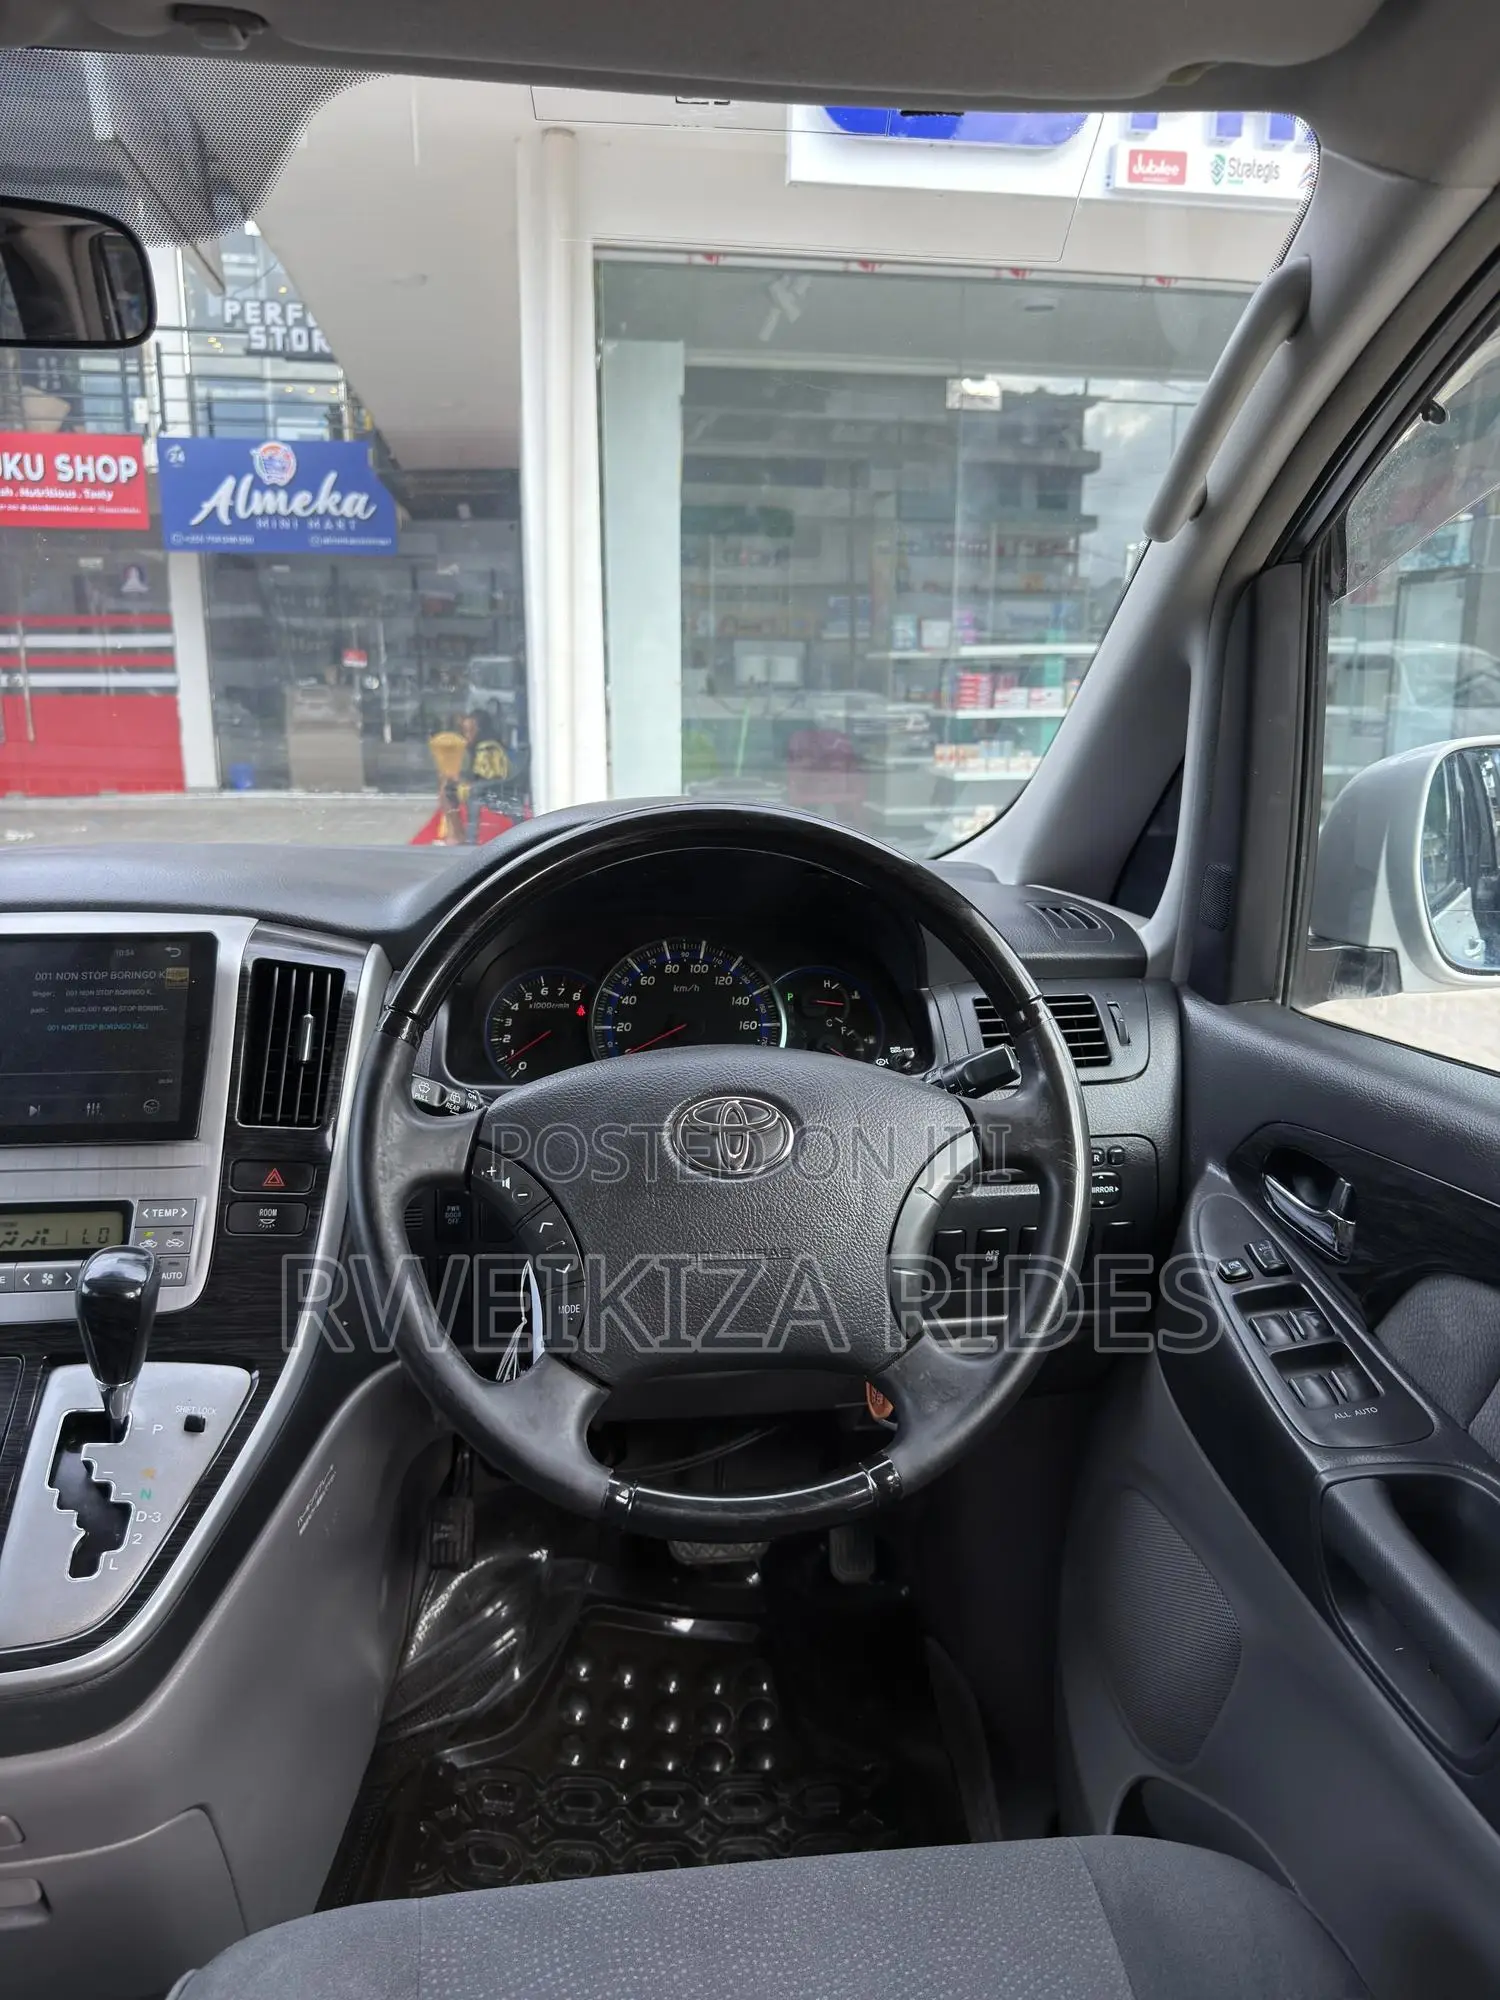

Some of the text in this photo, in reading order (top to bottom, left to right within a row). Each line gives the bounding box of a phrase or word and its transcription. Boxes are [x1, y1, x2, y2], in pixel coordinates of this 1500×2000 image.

[1132, 153, 1180, 177] Jubilee
[1227, 157, 1280, 183] Strategis
[0, 452, 138, 483] KU SHOP
[189, 470, 377, 526] Almeka
[256, 519, 356, 531] MINI MART
[664, 964, 680, 974] 80
[690, 964, 709, 974] 100
[35, 972, 52, 981] 001
[56, 972, 79, 981] NON
[81, 971, 108, 980] STOP
[110, 970, 156, 980] BORINGO
[640, 976, 656, 986] 60
[715, 976, 733, 986] 120
[823, 980, 831, 988] H
[540, 987, 549, 996] 6
[557, 987, 566, 996] 7
[673, 984, 700, 992] km/h
[524, 992, 533, 1001] 5
[572, 992, 581, 1001] 8
[621, 995, 637, 1005] 40
[731, 996, 750, 1006] 140
[787, 992, 794, 1001] P
[510, 1002, 520, 1011] 4
[504, 1018, 513, 1027] 3
[616, 1022, 632, 1032] 20
[739, 1020, 758, 1031] 160
[826, 1018, 833, 1027] C
[502, 1034, 512, 1043] 2
[518, 1061, 528, 1071] 0
[414, 1092, 429, 1102] PULL
[467, 1092, 478, 1101] ON
[445, 1102, 461, 1112] REAR
[1093, 1154, 1101, 1162] R
[152, 1208, 179, 1217] TEMP
[259, 1208, 278, 1216] ROOM
[161, 1271, 183, 1280] AUTO
[558, 1304, 580, 1314] MODE
[1334, 1406, 1378, 1420] ALL AUTO
[152, 1424, 163, 1435] P
[140, 1488, 152, 1499] N
[136, 1510, 162, 1523] D-3
[132, 1533, 143, 1545] 2
[109, 1558, 118, 1570] L
